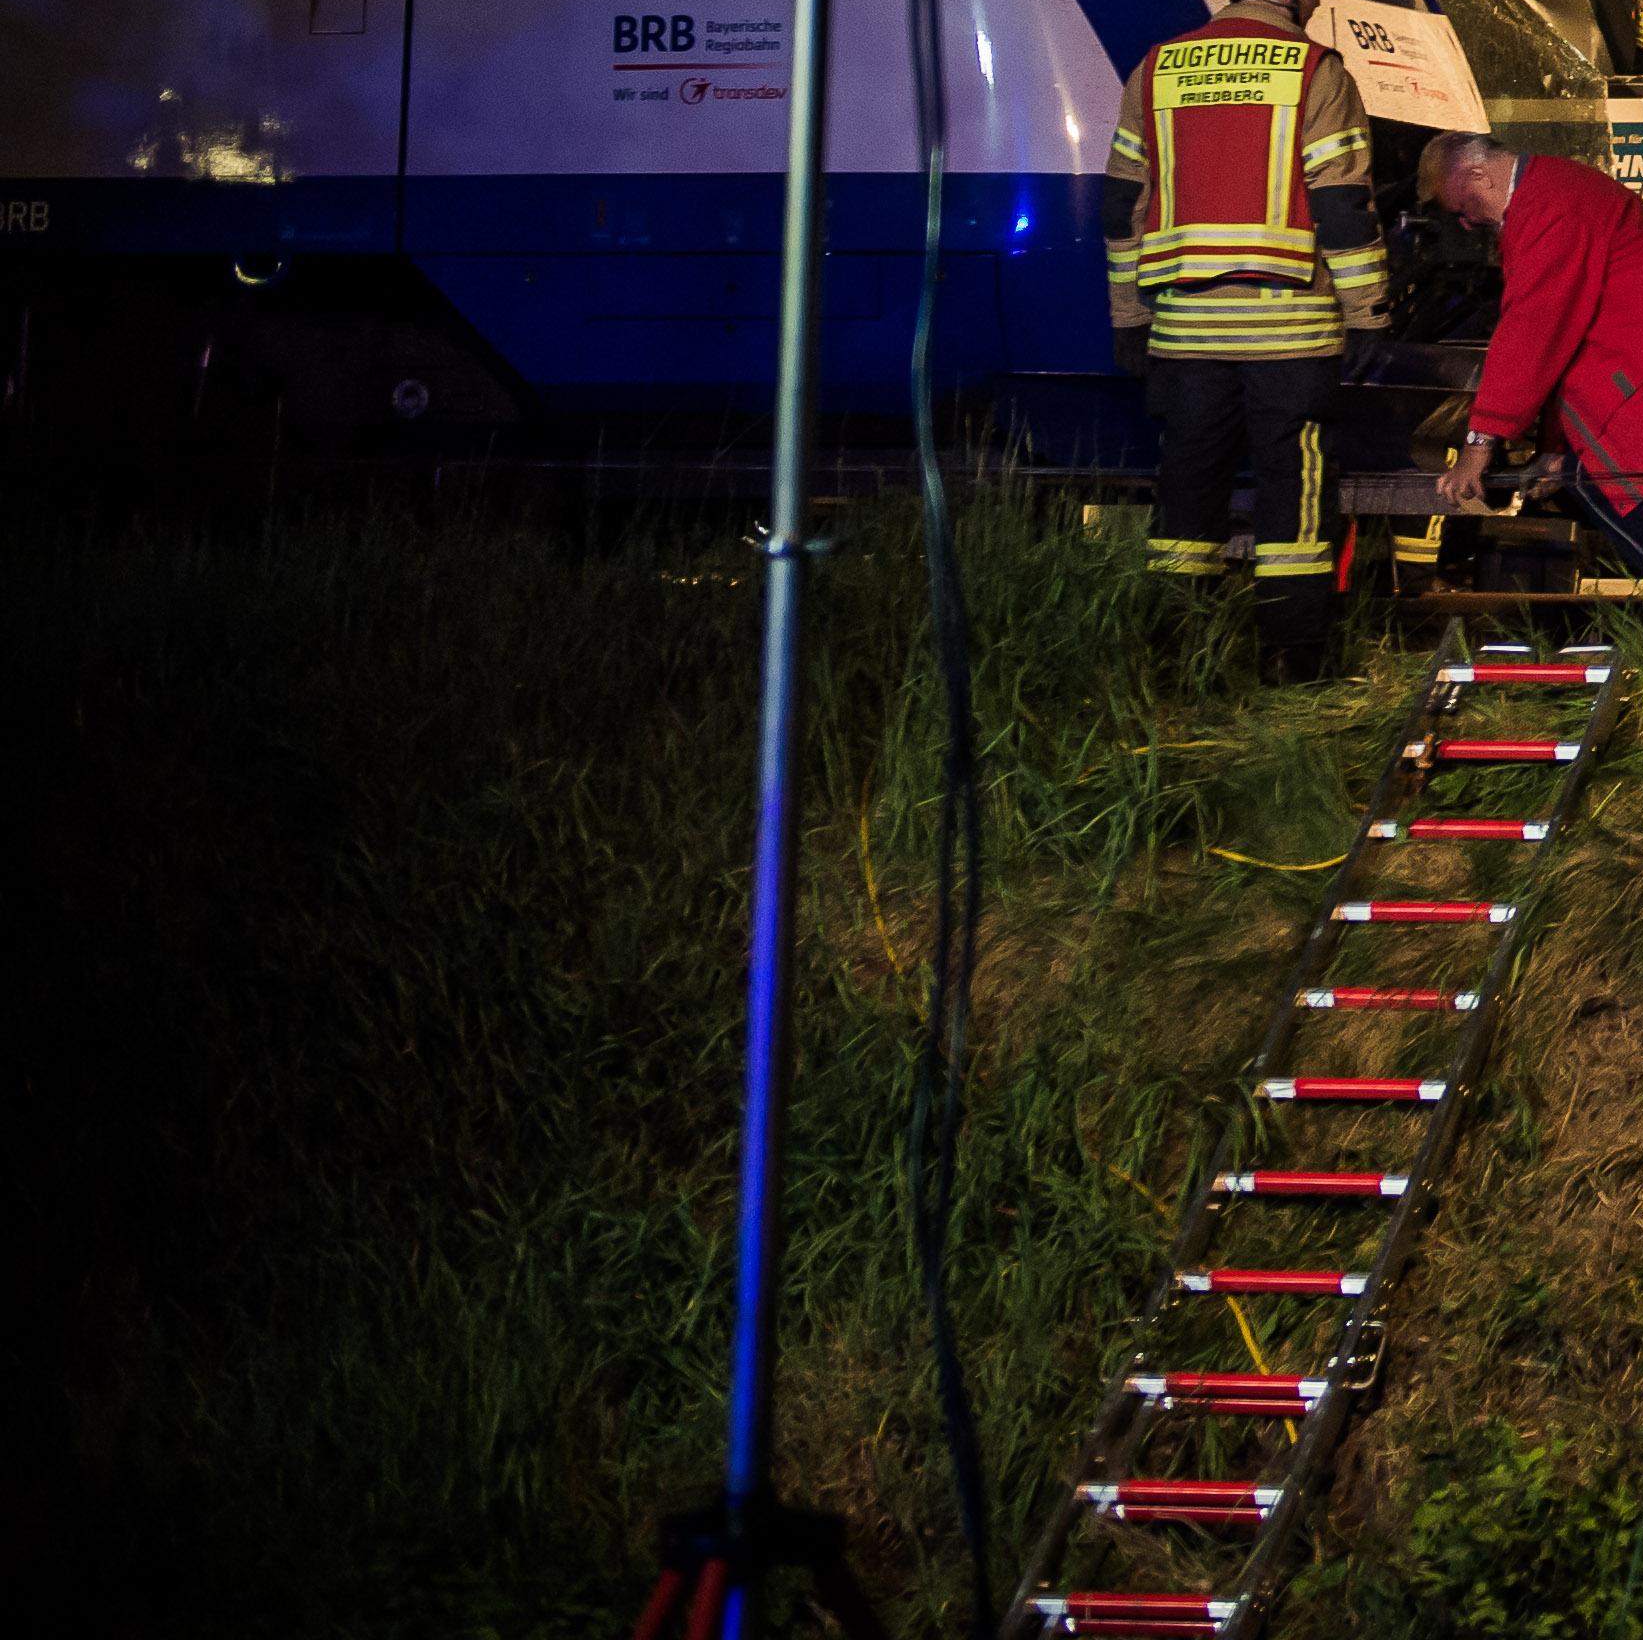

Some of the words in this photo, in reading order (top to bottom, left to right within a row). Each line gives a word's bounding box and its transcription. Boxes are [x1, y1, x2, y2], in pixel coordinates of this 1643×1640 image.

[613, 14, 695, 53] BRB
[706, 19, 782, 35] Bayerische
[1347, 19, 1395, 54] BRB
[705, 38, 781, 54] Regiobahn
[1177, 72, 1271, 87] FEUERWEHR
[640, 86, 669, 101] sind
[713, 84, 788, 99] transdev
[1180, 90, 1265, 104] FRIEDBERG
